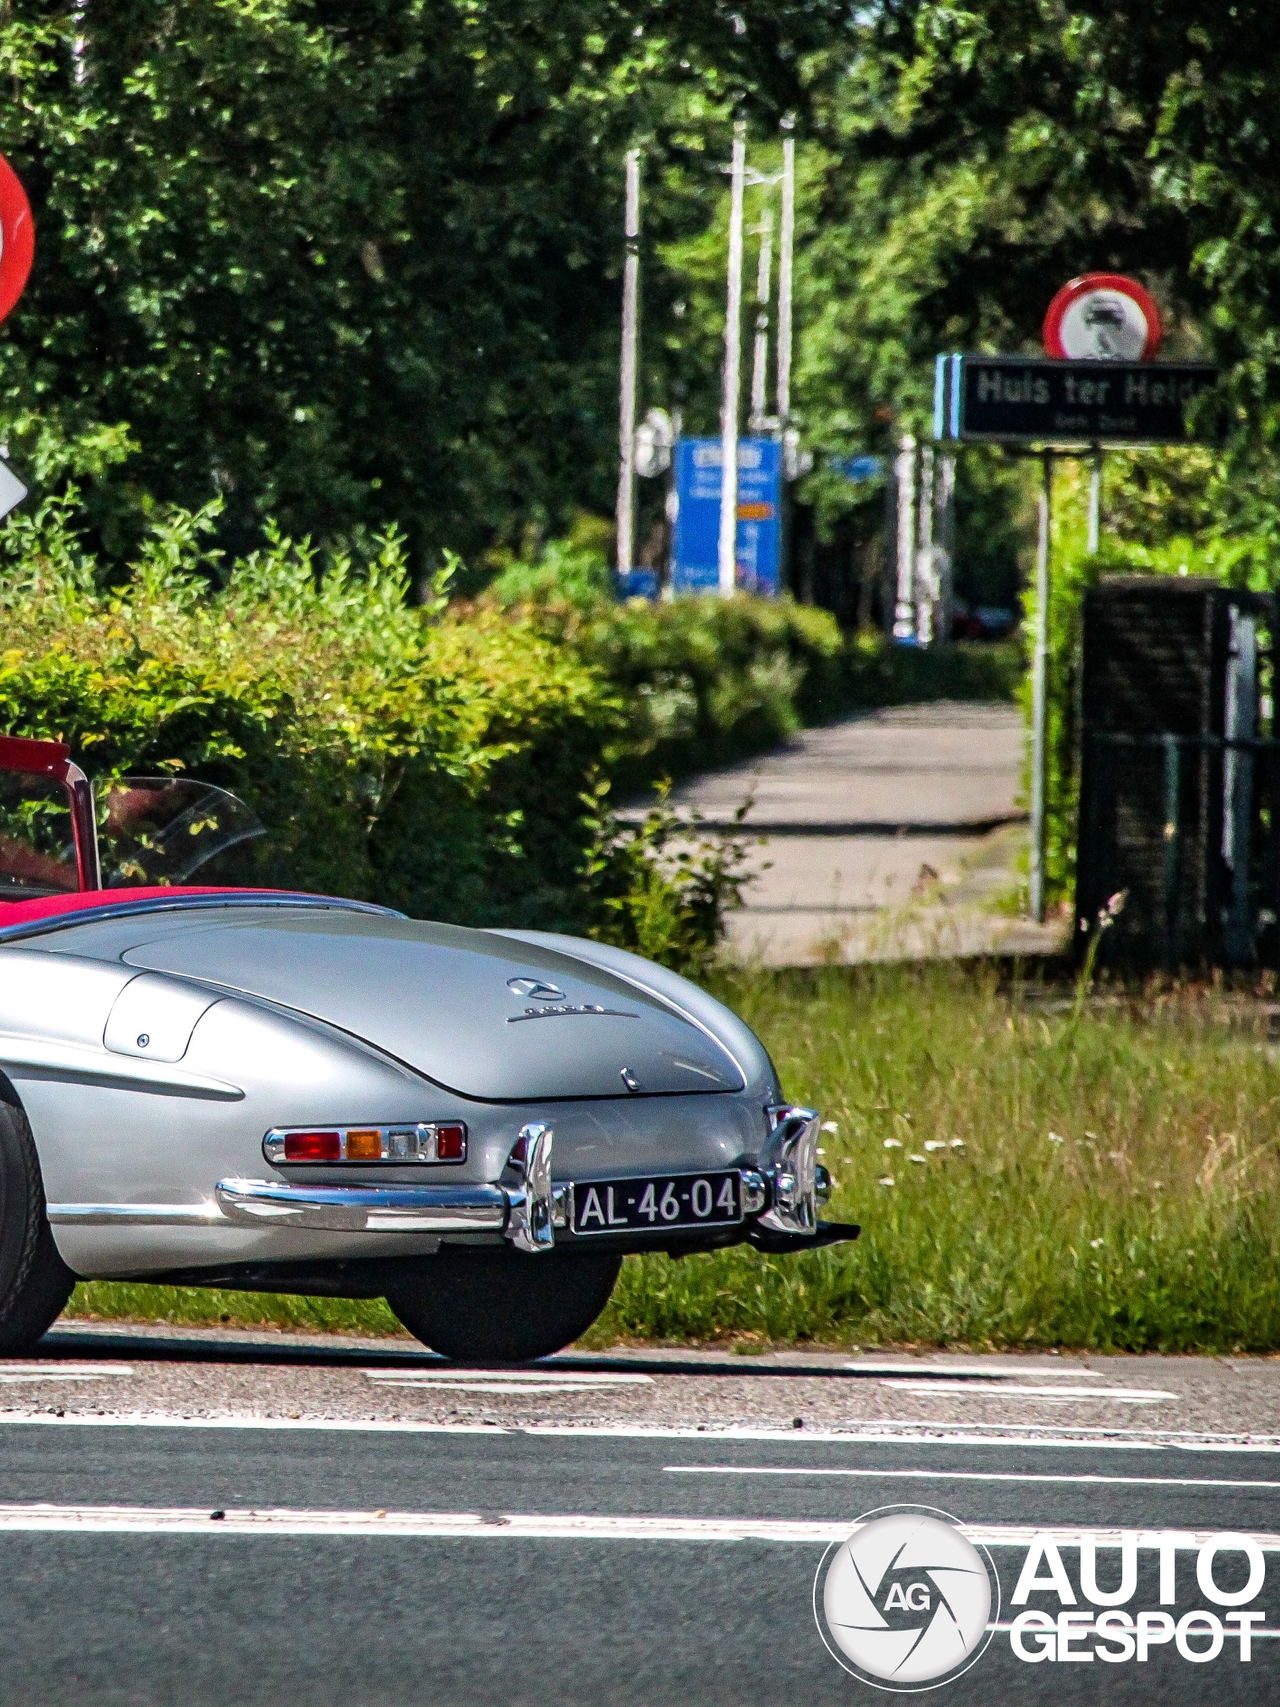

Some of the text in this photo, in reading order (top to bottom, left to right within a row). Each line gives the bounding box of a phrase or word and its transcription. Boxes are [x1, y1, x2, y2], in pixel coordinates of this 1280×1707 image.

[976, 369, 1051, 404] Huis
[1064, 371, 1111, 405] ter
[580, 1177, 737, 1227] AL-46-04
